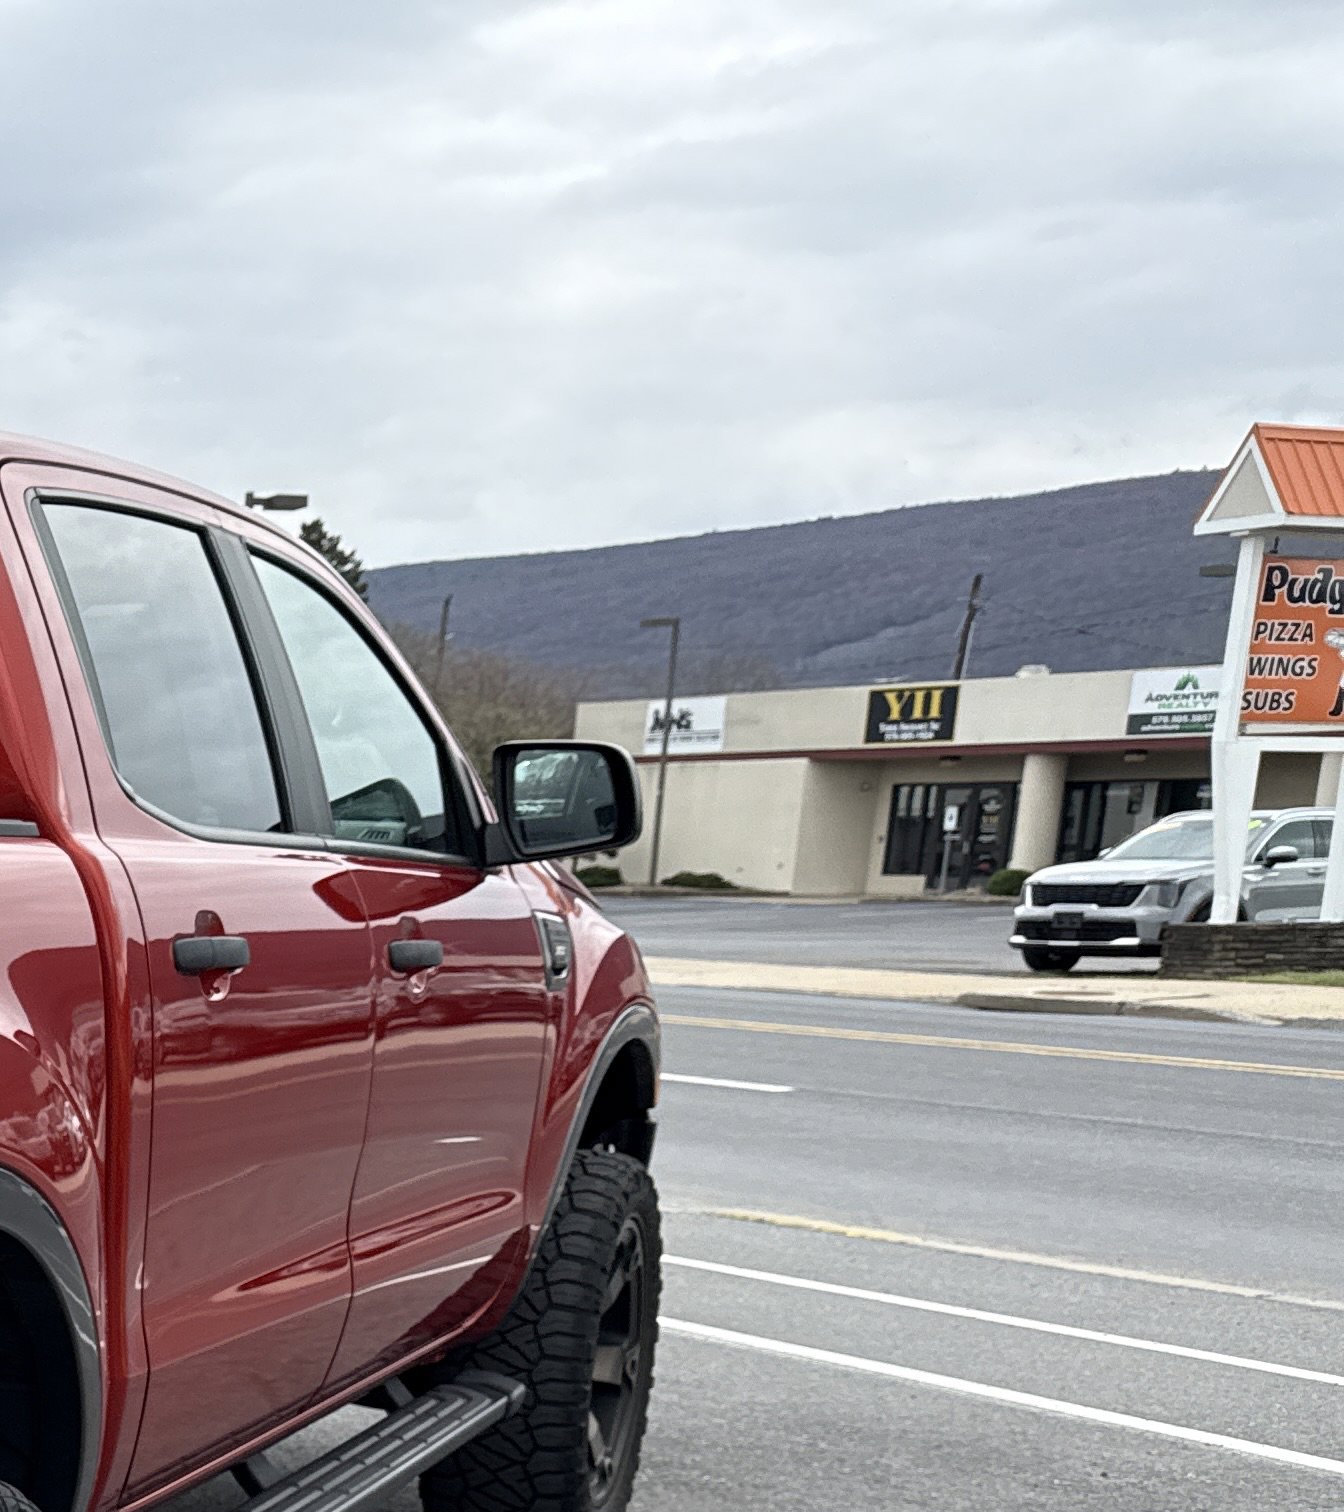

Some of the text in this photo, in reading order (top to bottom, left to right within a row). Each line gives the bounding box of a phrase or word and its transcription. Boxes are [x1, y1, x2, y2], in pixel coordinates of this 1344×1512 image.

[1253, 621, 1315, 643] PIZZA
[1248, 656, 1319, 678] WINGS
[883, 688, 945, 720] YII
[1240, 690, 1296, 712] SUBS
